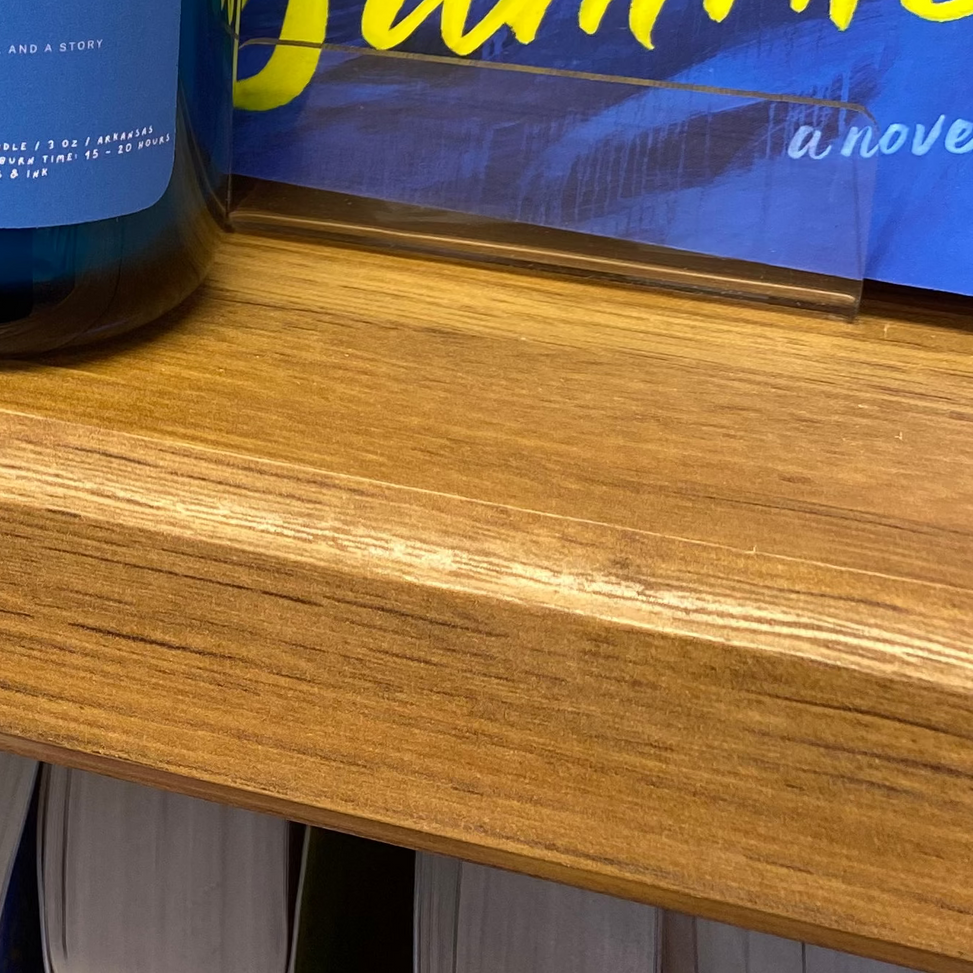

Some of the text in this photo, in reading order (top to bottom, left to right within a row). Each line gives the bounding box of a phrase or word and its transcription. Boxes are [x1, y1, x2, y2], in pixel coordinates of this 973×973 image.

[8, 43, 38, 55] AND
[43, 43, 53, 54] A
[59, 39, 104, 53] STORY
[61, 138, 78, 148] OZ
[97, 125, 154, 146] ARKANSAS
[787, 125, 832, 160] a
[42, 152, 78, 164] TIME:
[84, 148, 100, 161] 15
[117, 142, 133, 155] 20
[137, 133, 171, 151] HOURS
[9, 168, 19, 179] &
[26, 167, 48, 179] INK
